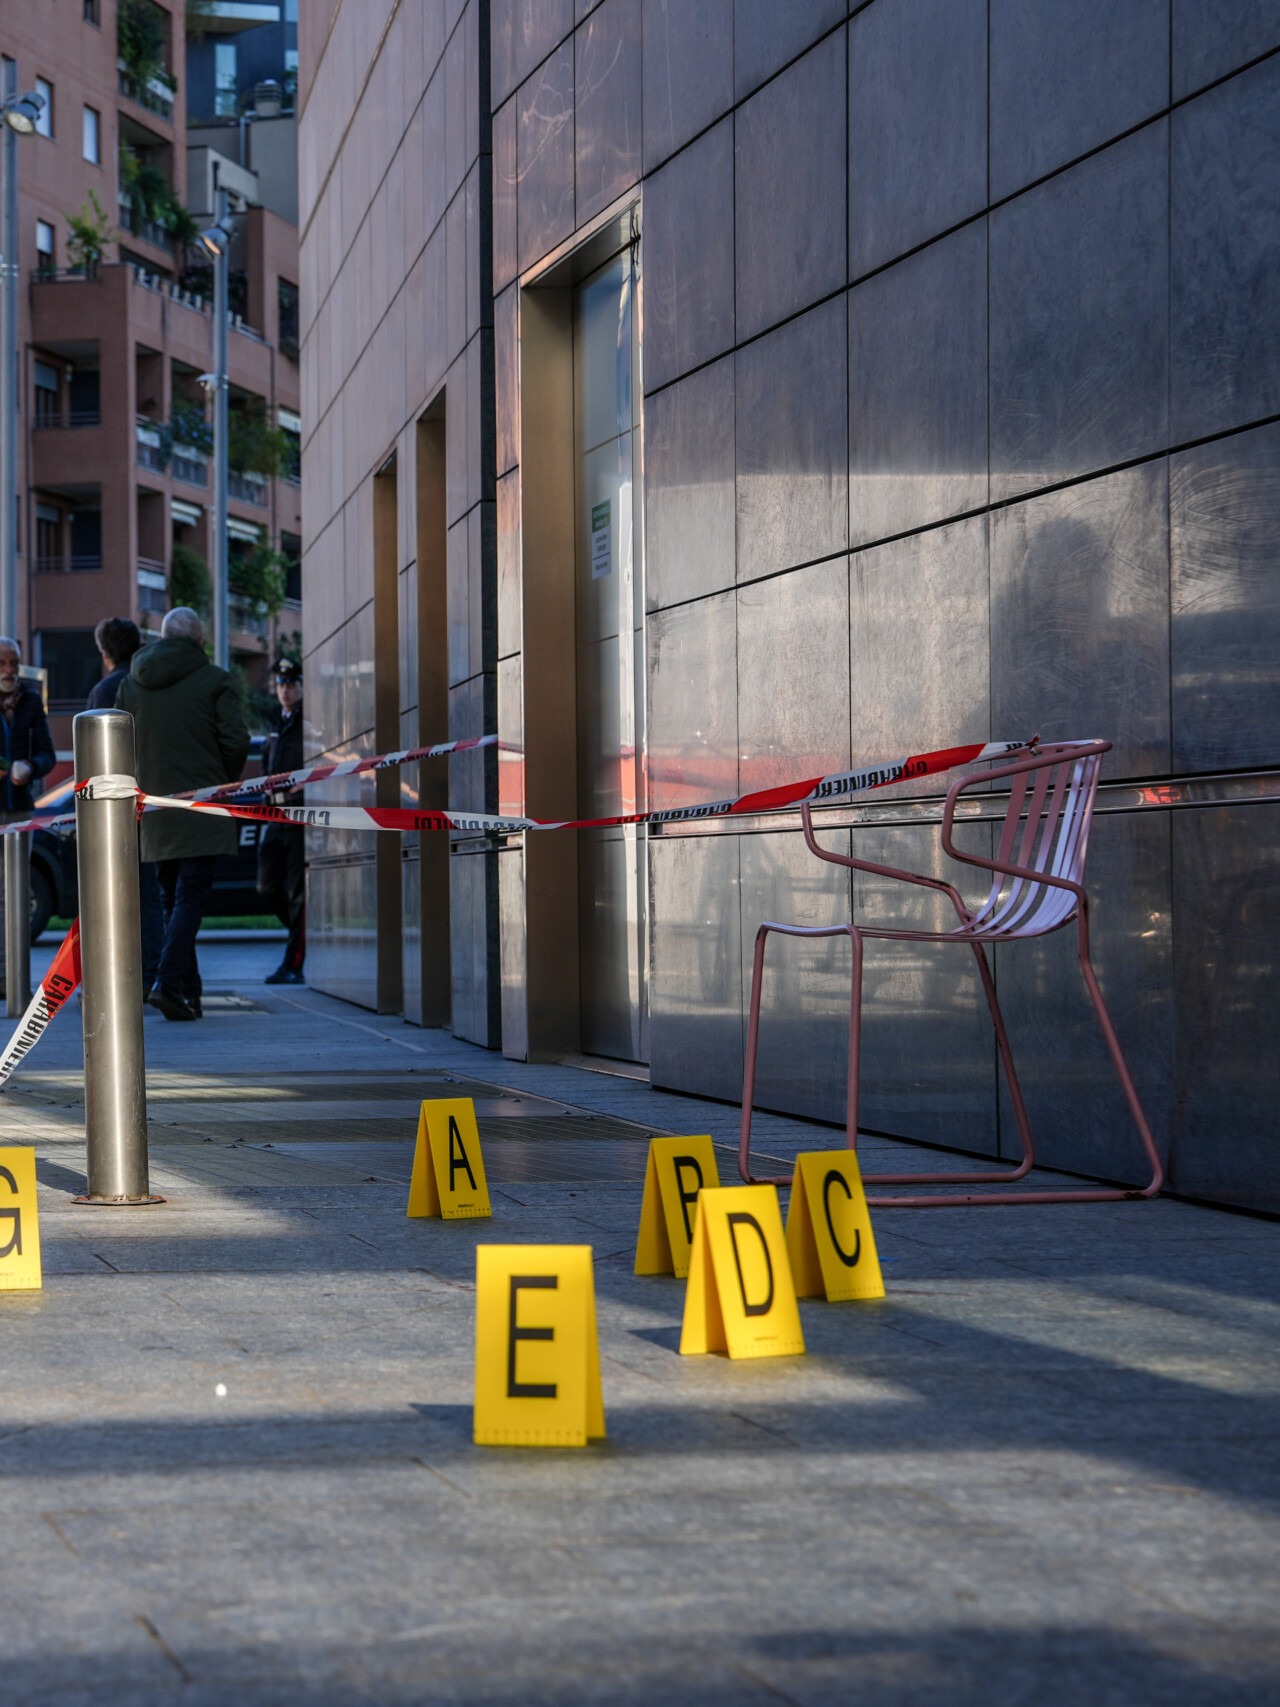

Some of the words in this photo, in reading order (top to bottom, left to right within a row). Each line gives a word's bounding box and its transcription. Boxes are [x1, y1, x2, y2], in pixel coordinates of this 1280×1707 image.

[448, 1115, 478, 1191] A
[726, 1212, 775, 1318] D
[822, 1169, 861, 1268] C
[506, 1275, 559, 1399] E
